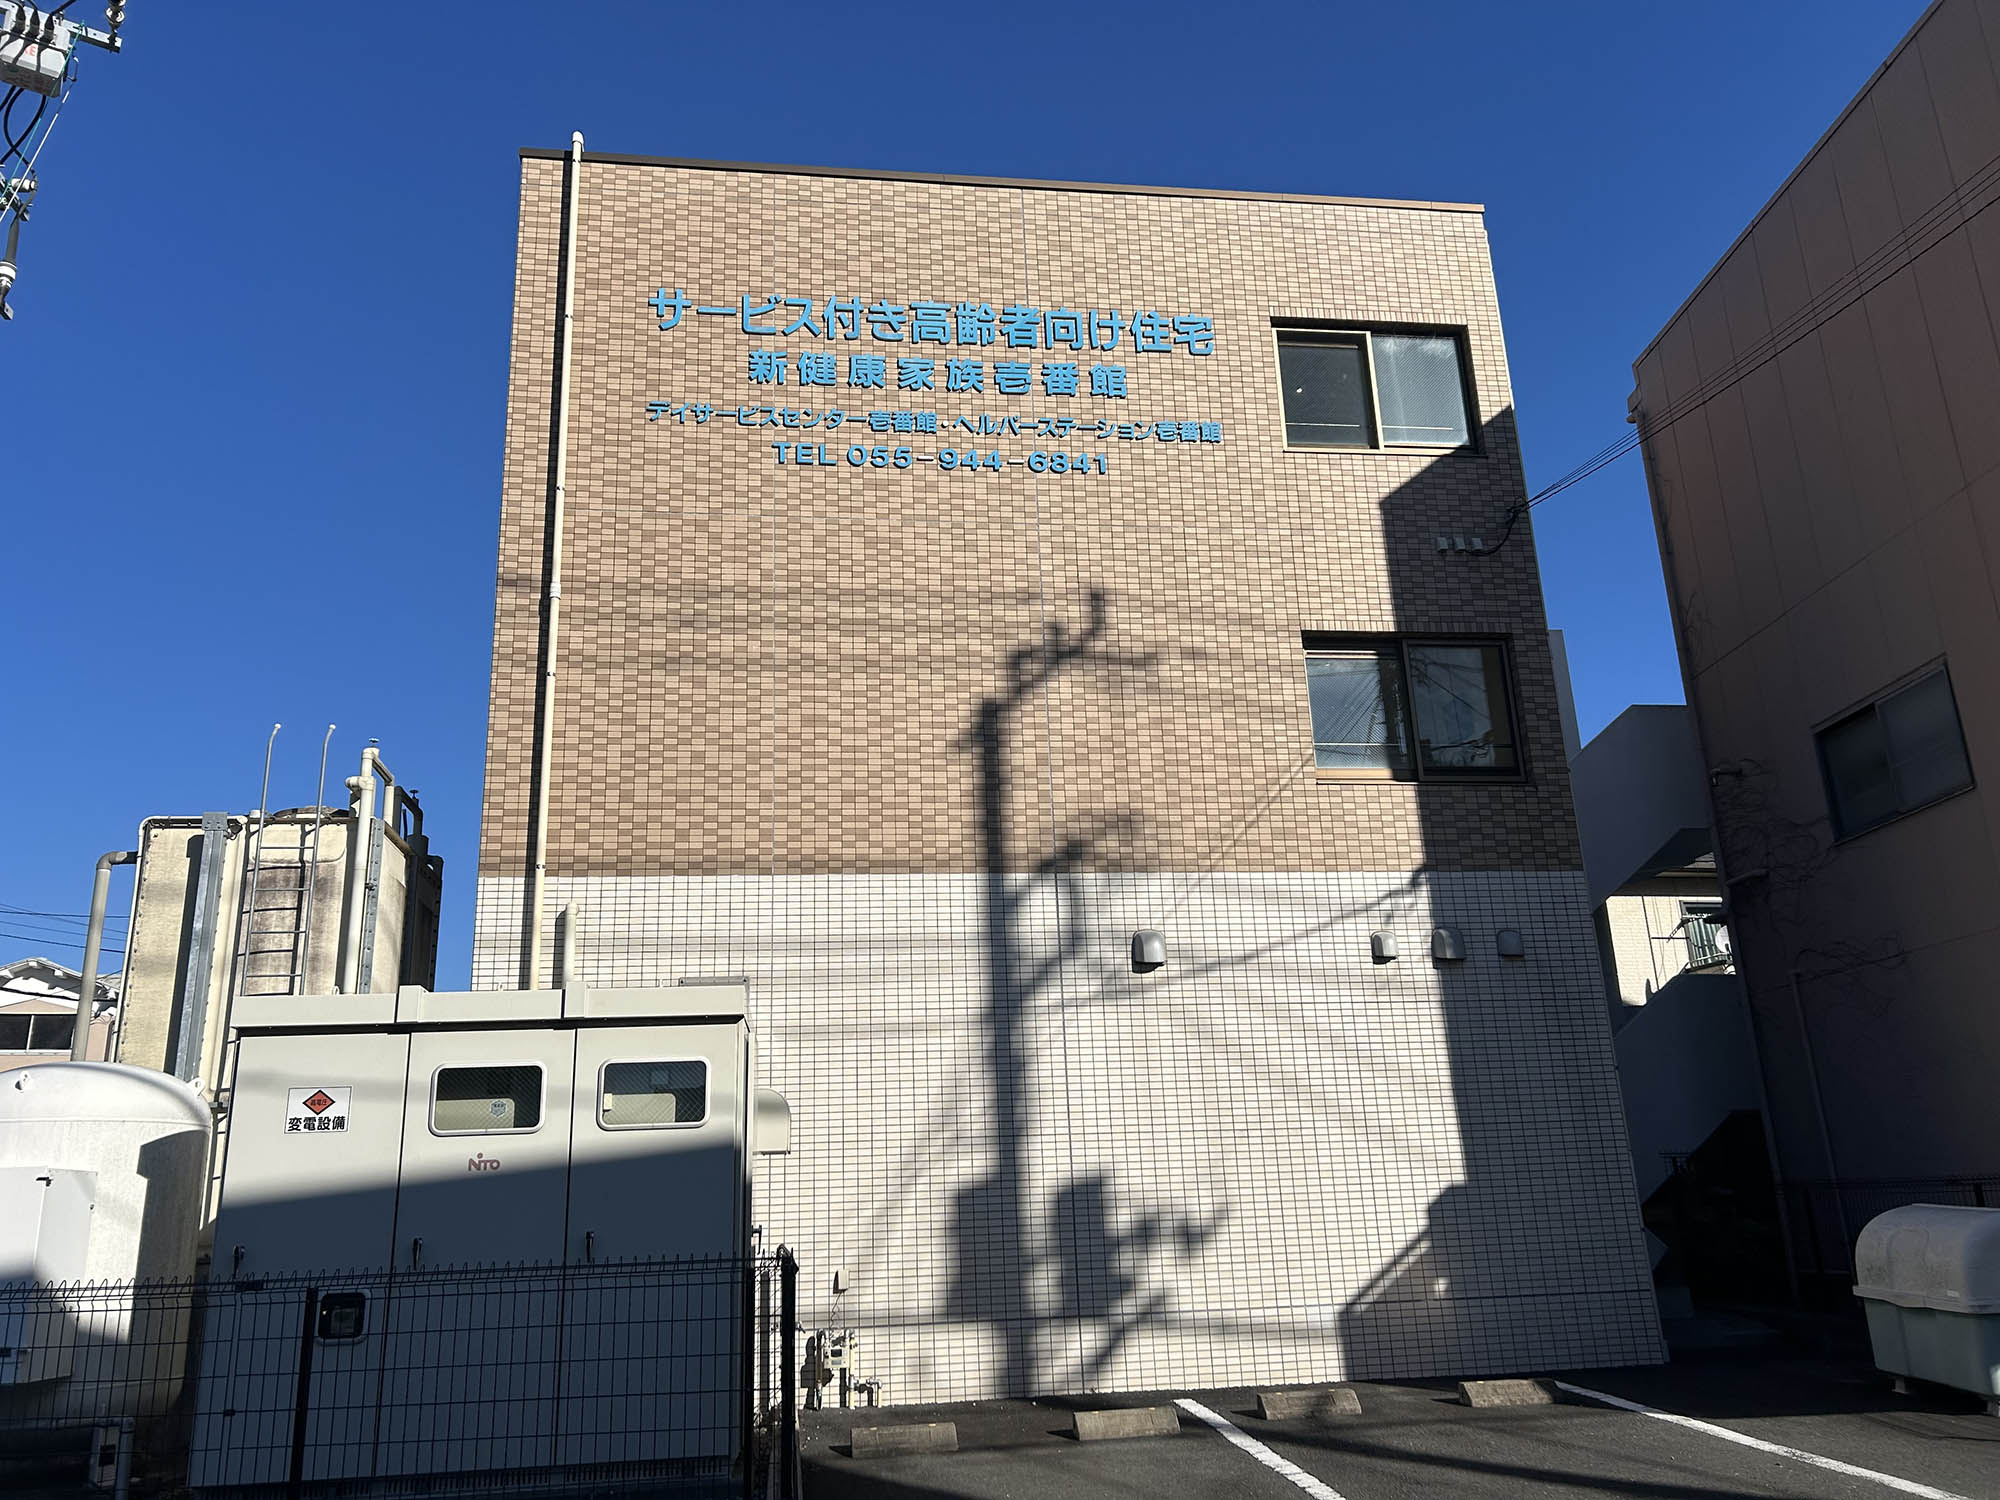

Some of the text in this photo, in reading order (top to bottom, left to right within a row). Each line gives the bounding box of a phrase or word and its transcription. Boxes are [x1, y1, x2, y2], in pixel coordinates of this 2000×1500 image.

[648, 287, 1214, 355] サービス付き高齢者向け住宅
[748, 348, 1127, 399] 新健康家族壱番館
[771, 441, 1107, 474] TEL 055-944-6841
[288, 1116, 346, 1131] 変電設備
